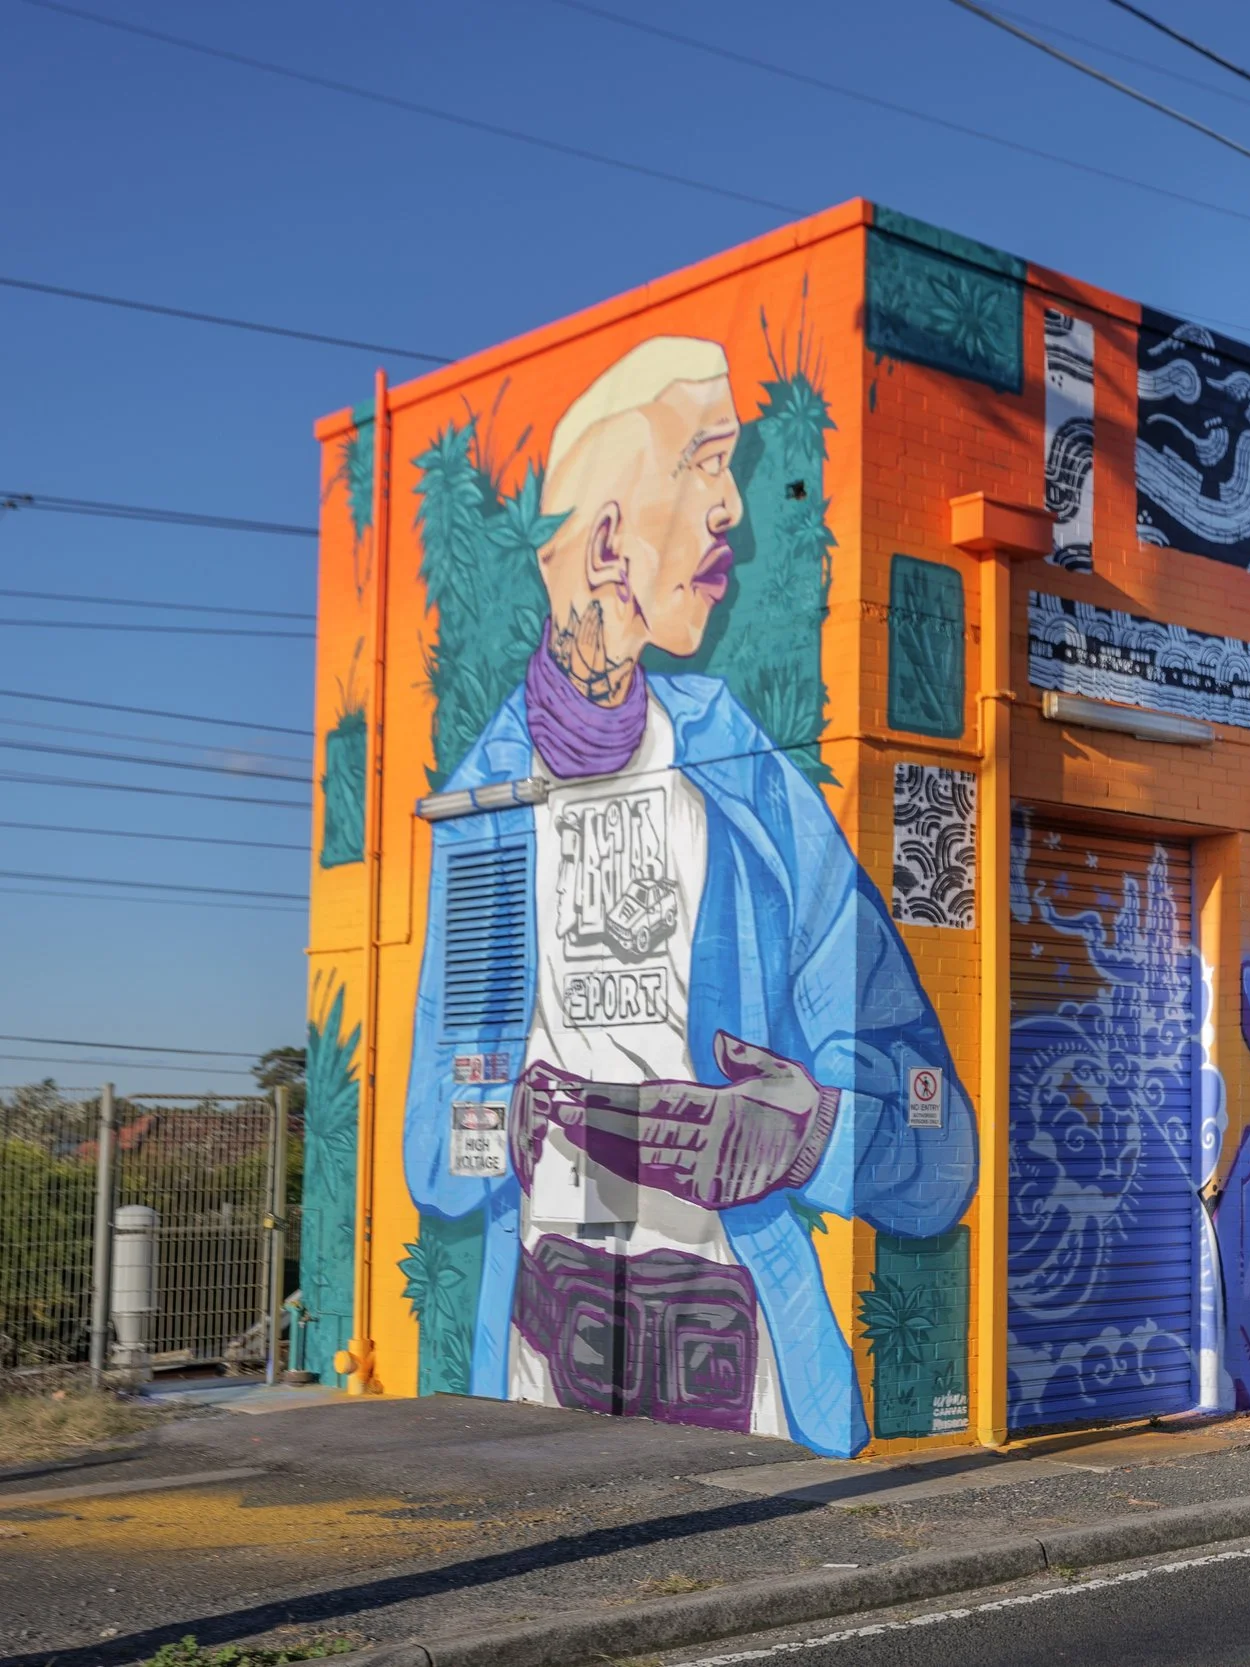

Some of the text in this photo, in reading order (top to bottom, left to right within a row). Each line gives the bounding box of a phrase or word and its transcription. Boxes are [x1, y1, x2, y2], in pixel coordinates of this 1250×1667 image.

[566, 973, 663, 1021] SPORT
[911, 1103, 940, 1111] NO ENTRY
[465, 1137, 490, 1151] HIGH
[456, 1155, 501, 1169] VOLTAGE
[933, 1406, 967, 1417] CANVAS
